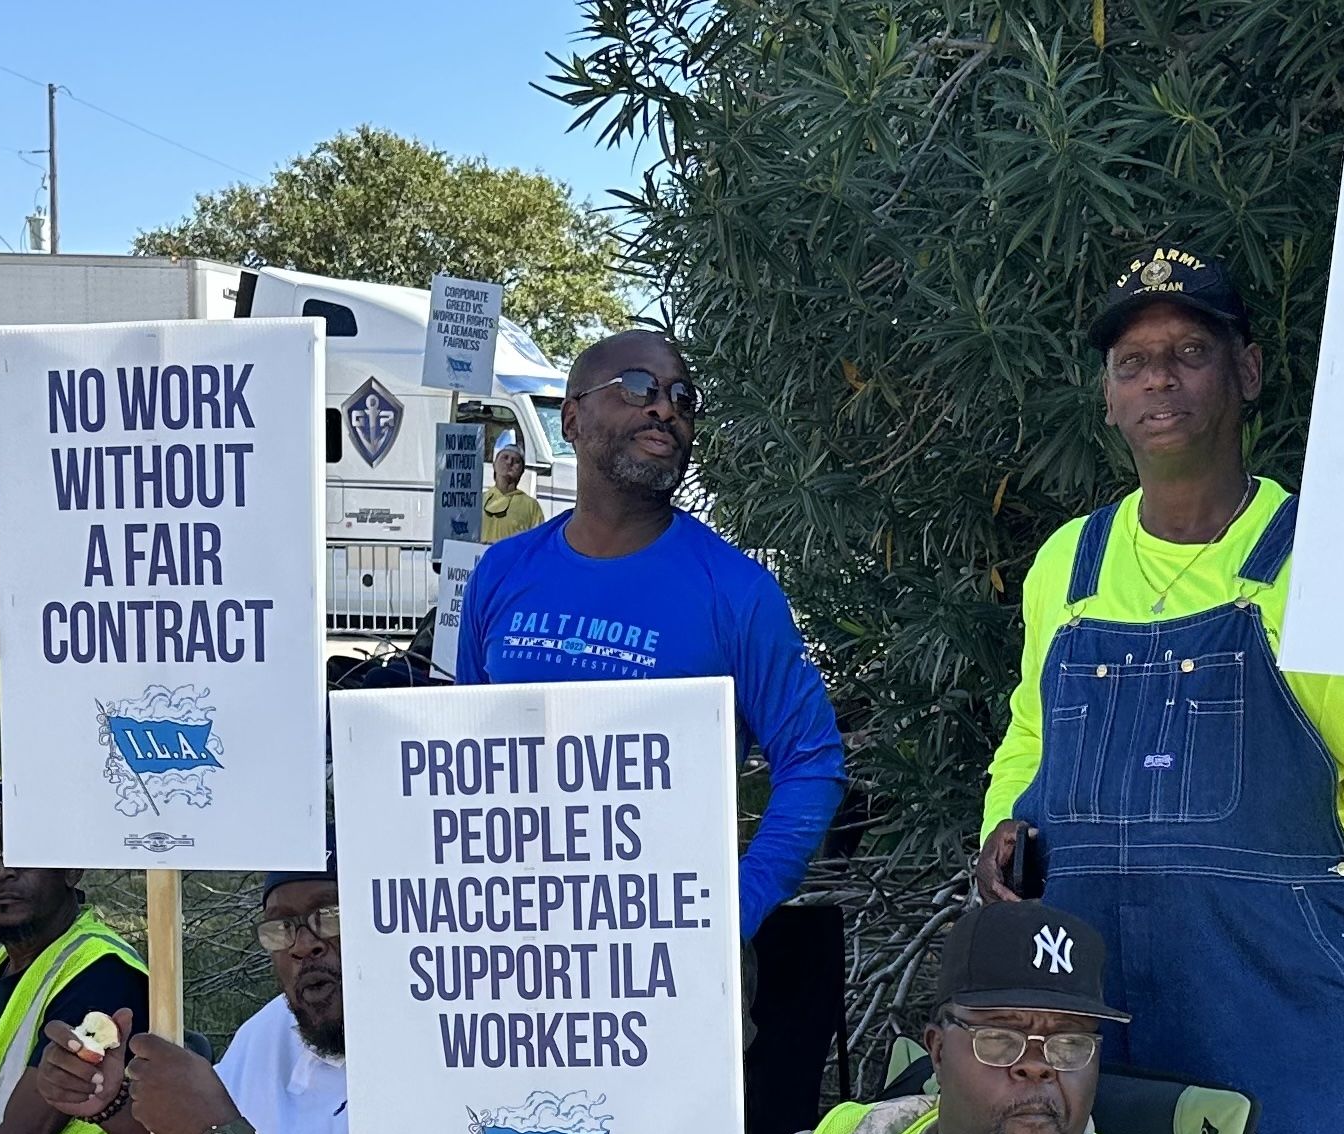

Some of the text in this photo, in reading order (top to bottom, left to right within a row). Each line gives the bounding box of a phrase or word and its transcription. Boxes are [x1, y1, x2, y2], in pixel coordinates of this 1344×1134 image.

[1153, 248, 1206, 271] ARMY
[444, 286, 489, 303] CORPORATE
[446, 298, 472, 313] GREED
[432, 309, 465, 324] WORKER
[443, 336, 481, 351] FAIRNESS
[451, 325, 489, 340] DEMANDS
[48, 364, 256, 433] NO WORK
[445, 434, 477, 450] NO WORK
[51, 443, 254, 511] WITHOUT
[446, 454, 477, 470] WITHOUT
[450, 473, 471, 489] A FAIR
[441, 492, 477, 508] CONTRACT
[84, 522, 222, 587] A FAIR
[42, 600, 274, 665] CONTRACT
[439, 612, 460, 628] JOBS
[509, 612, 660, 652] BALTIMORE
[564, 641, 583, 651] 2023
[502, 650, 648, 680] RUNNING FESTIVAL
[125, 729, 207, 762] I.L.A.
[401, 733, 671, 797] PROFIT OVER
[433, 804, 642, 865] PEOPLE IS
[372, 872, 711, 934] UNACCEPTABLE:
[1033, 925, 1074, 974] NY
[409, 942, 677, 1001] SUPPORT ILA
[439, 1011, 648, 1069] WORKERS
